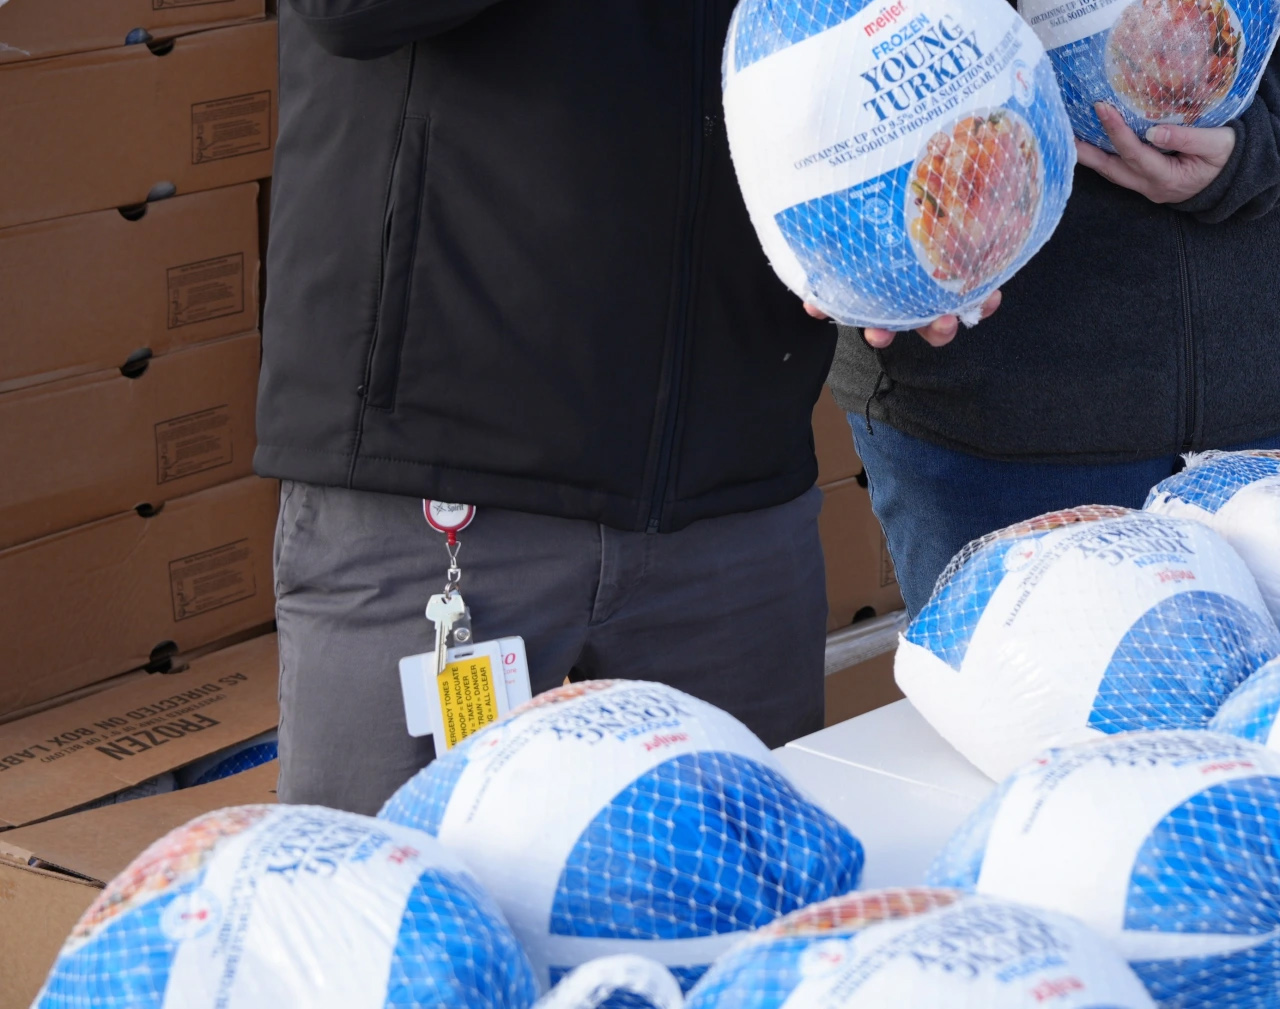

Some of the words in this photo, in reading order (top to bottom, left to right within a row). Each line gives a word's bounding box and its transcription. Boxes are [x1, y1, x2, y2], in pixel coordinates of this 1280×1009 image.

[864, 0, 908, 37] meijer
[1068, 2, 1100, 21] SODIUM
[872, 12, 931, 60] FROZEN
[860, 14, 964, 94] YOUNG
[863, 30, 984, 122] TURKEY
[853, 131, 868, 145] UP
[872, 123, 886, 138] TO
[888, 112, 914, 129] 9.5%
[914, 101, 930, 116] OF
[931, 95, 940, 106] A
[939, 62, 986, 98] SOLUTION
[855, 131, 899, 156] SODIUM
[1077, 524, 1188, 560] TURKEY
[1099, 539, 1196, 566] YOUNG
[218, 672, 248, 686] AS
[452, 666, 464, 705] EVACUATE
[462, 675, 472, 702] COVER
[470, 664, 480, 696] DANGER
[480, 666, 490, 692] CLEAR
[126, 682, 223, 720] DIRECTED
[442, 680, 452, 706] TONES
[94, 716, 129, 731] ON
[467, 702, 475, 722] TAKE
[475, 703, 485, 725] TRAIN
[46, 727, 96, 748] BOX
[96, 713, 221, 761] FROZEN
[40, 742, 85, 764] BELOW)
